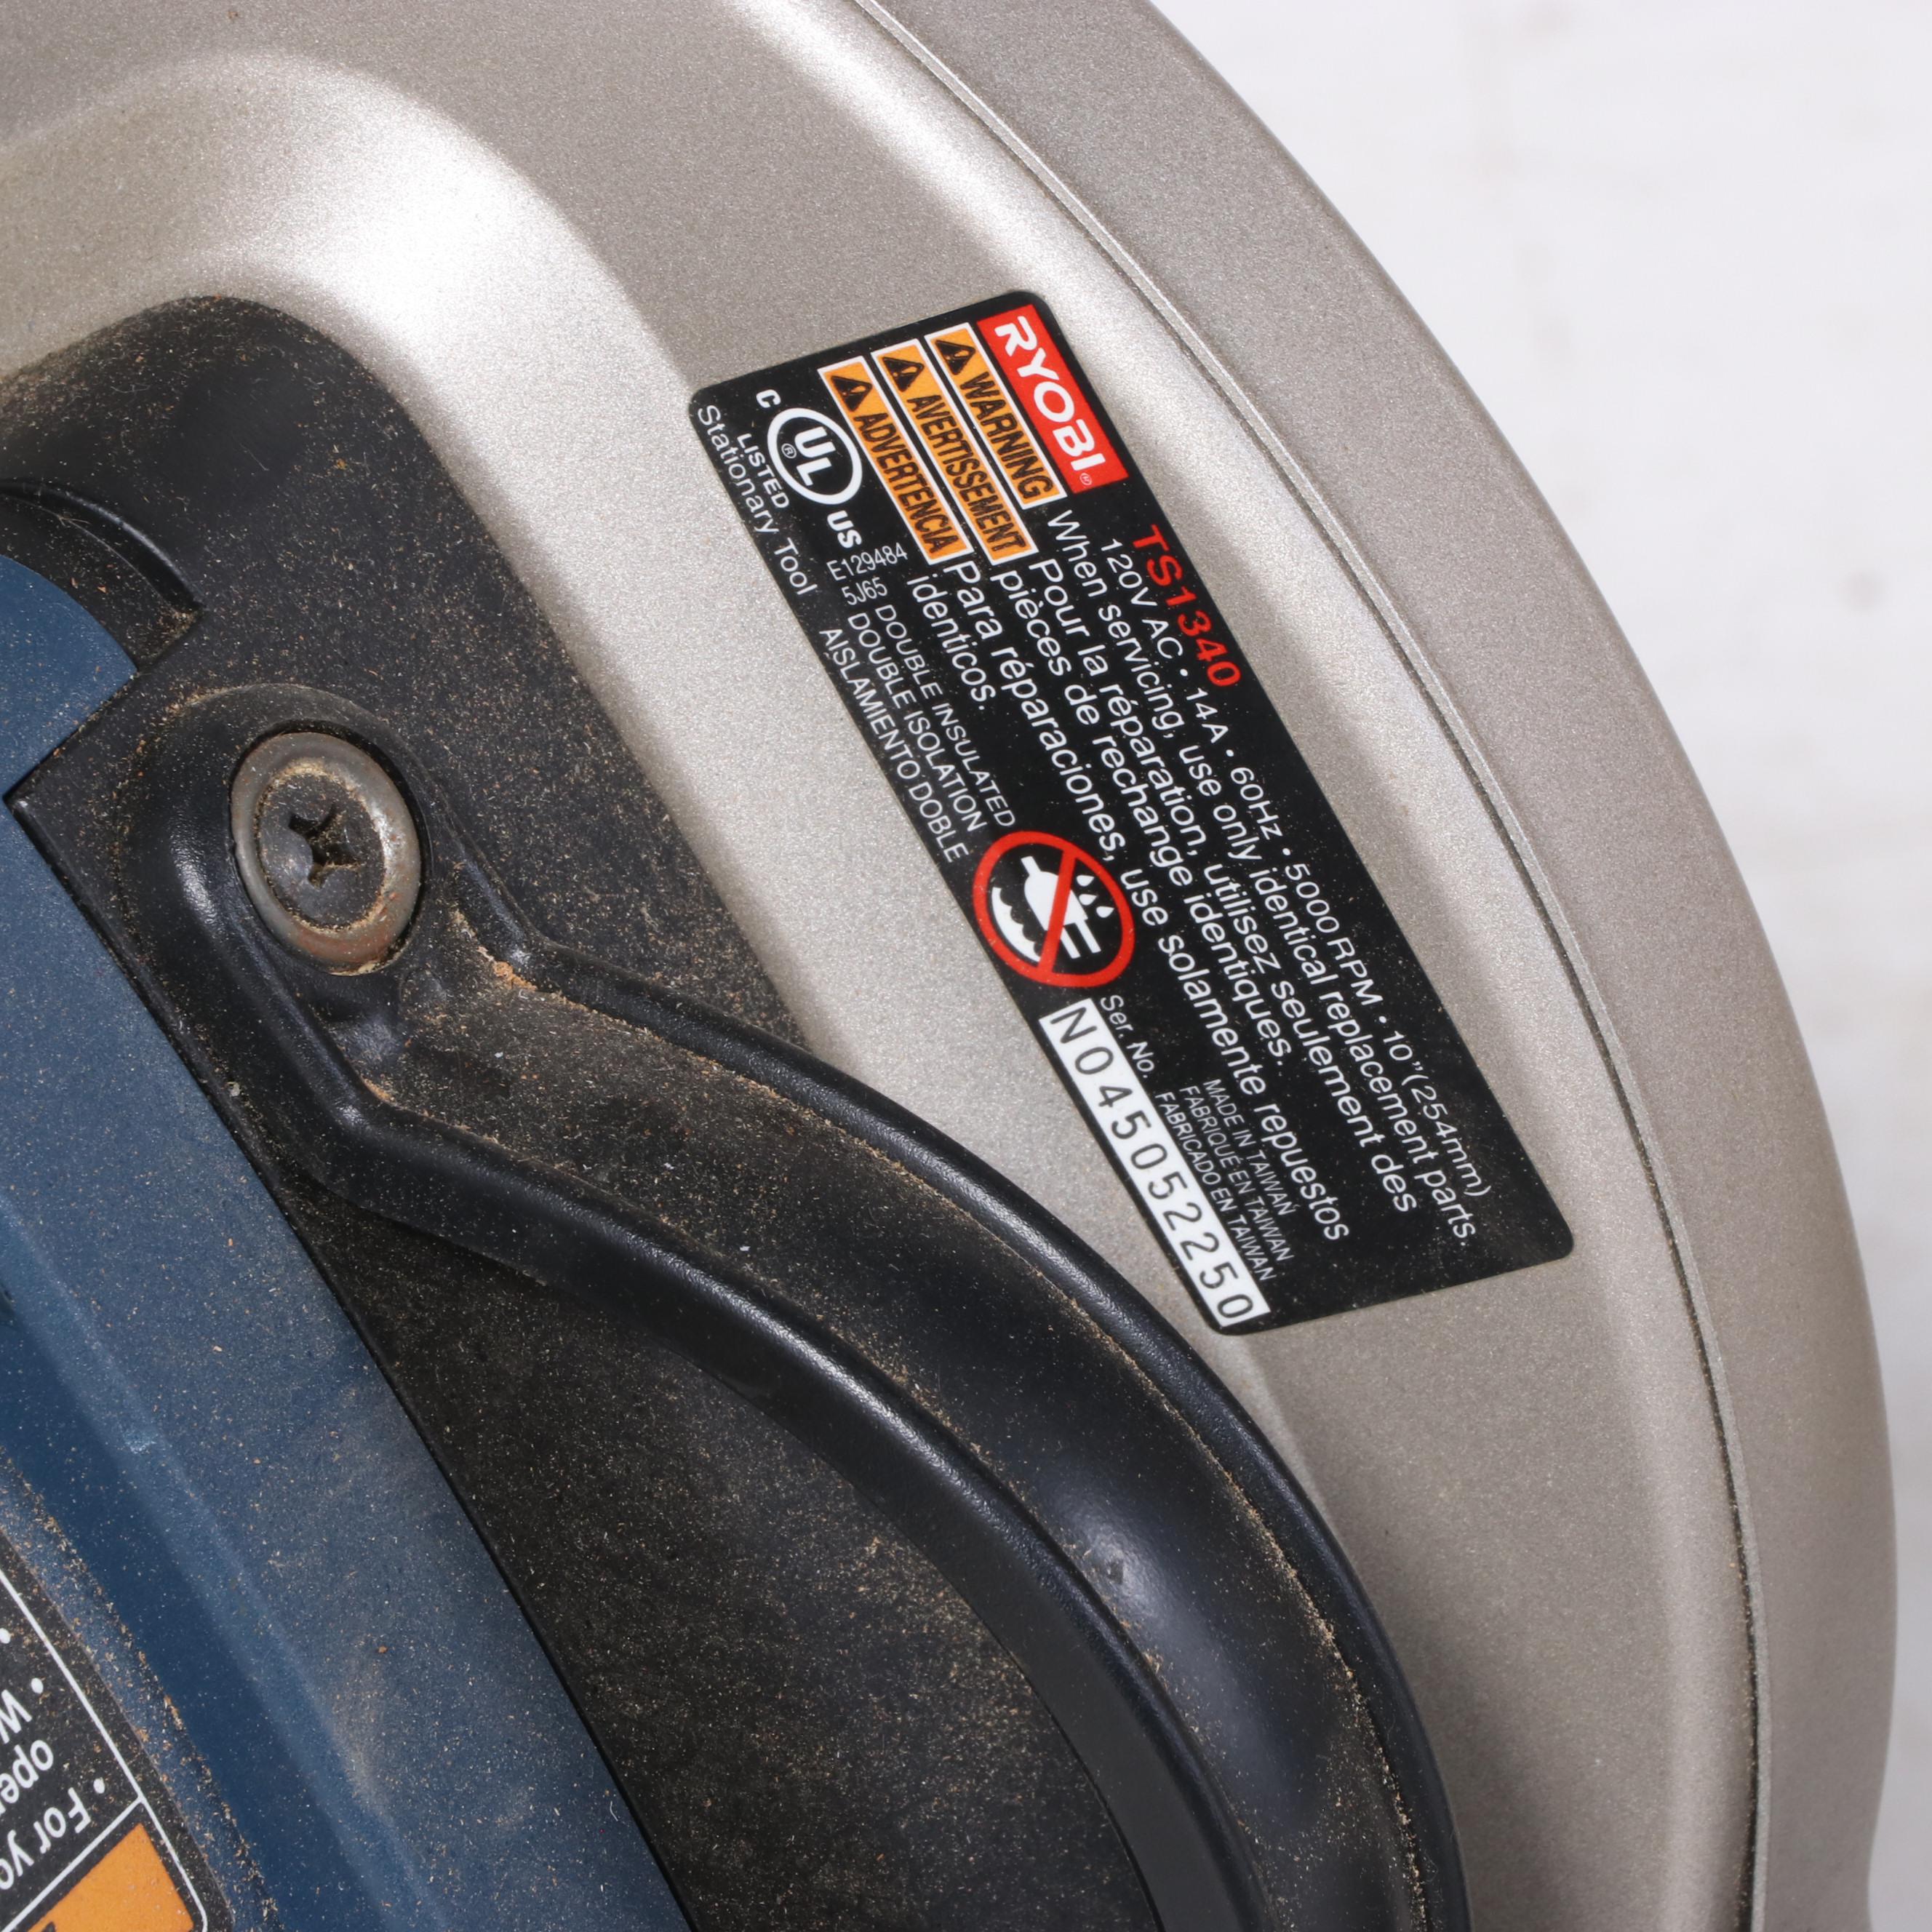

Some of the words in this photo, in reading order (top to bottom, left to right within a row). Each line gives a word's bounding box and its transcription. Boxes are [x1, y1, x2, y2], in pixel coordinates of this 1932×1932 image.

[697, 404, 780, 534] Stationary
[773, 537, 818, 595] Tool
[736, 433, 790, 508] LISTED
[853, 412, 959, 554] ADVERTENCIA
[906, 394, 1026, 552] AVERTISSEMENT
[959, 371, 1054, 499] WARNING
[826, 510, 863, 548] US
[826, 542, 908, 581] E129484
[841, 576, 888, 606] 5J65
[1133, 524, 1242, 687] TS1340
[847, 612, 917, 709] DOUBLE
[903, 710, 988, 832] ISOLATION
[874, 604, 943, 699] DOUBLE
[931, 703, 1015, 826] INSULATED
[906, 573, 997, 711] identicos.
[1101, 538, 1158, 607] 120V
[1141, 619, 1183, 659] AC
[1186, 687, 1229, 743] 14A
[1230, 767, 1283, 840] 60Hz
[818, 628, 921, 780] AISLAMIENTO
[908, 781, 970, 863] DOBLE
[989, 570, 1072, 676] pièces
[1064, 684, 1101, 725] de
[1092, 735, 1193, 887] rechange
[1183, 892, 1292, 1066] identiques.
[942, 560, 1003, 640] Para
[1120, 869, 1169, 926] use
[1157, 935, 1266, 1095] solamente
[1253, 1103, 1349, 1240] repuestos
[1028, 558, 1090, 636] Pour
[1077, 644, 1109, 676] la
[1098, 684, 1207, 856] réparation,
[1203, 863, 1282, 974] utilisez
[1270, 981, 1386, 1148] seulement
[1370, 1154, 1417, 1212] des
[1047, 509, 1108, 597] When
[1098, 604, 1185, 738] servicing,
[1178, 745, 1222, 797] use
[1213, 805, 1262, 860] only
[1248, 867, 1339, 985] identical
[1319, 991, 1439, 1164] replacement
[1413, 1169, 1476, 1246] parts.
[1100, 994, 1133, 1038] Ser.
[1126, 1041, 1154, 1079] No.
[1154, 1092, 1221, 1185] FABRICADO
[1210, 1188, 1238, 1212] EN
[1227, 1214, 1277, 1281] TAIWAN
[1179, 1085, 1244, 1168] FABRIQUÉ
[1227, 1170, 1256, 1194] EN
[1245, 1196, 1294, 1261] TAIWAN
[1203, 1079, 1245, 1127] MADE
[1232, 1129, 1256, 1147] IN
[1246, 1149, 1296, 1216] TAIWAN
[33, 1787, 92, 1854] For
